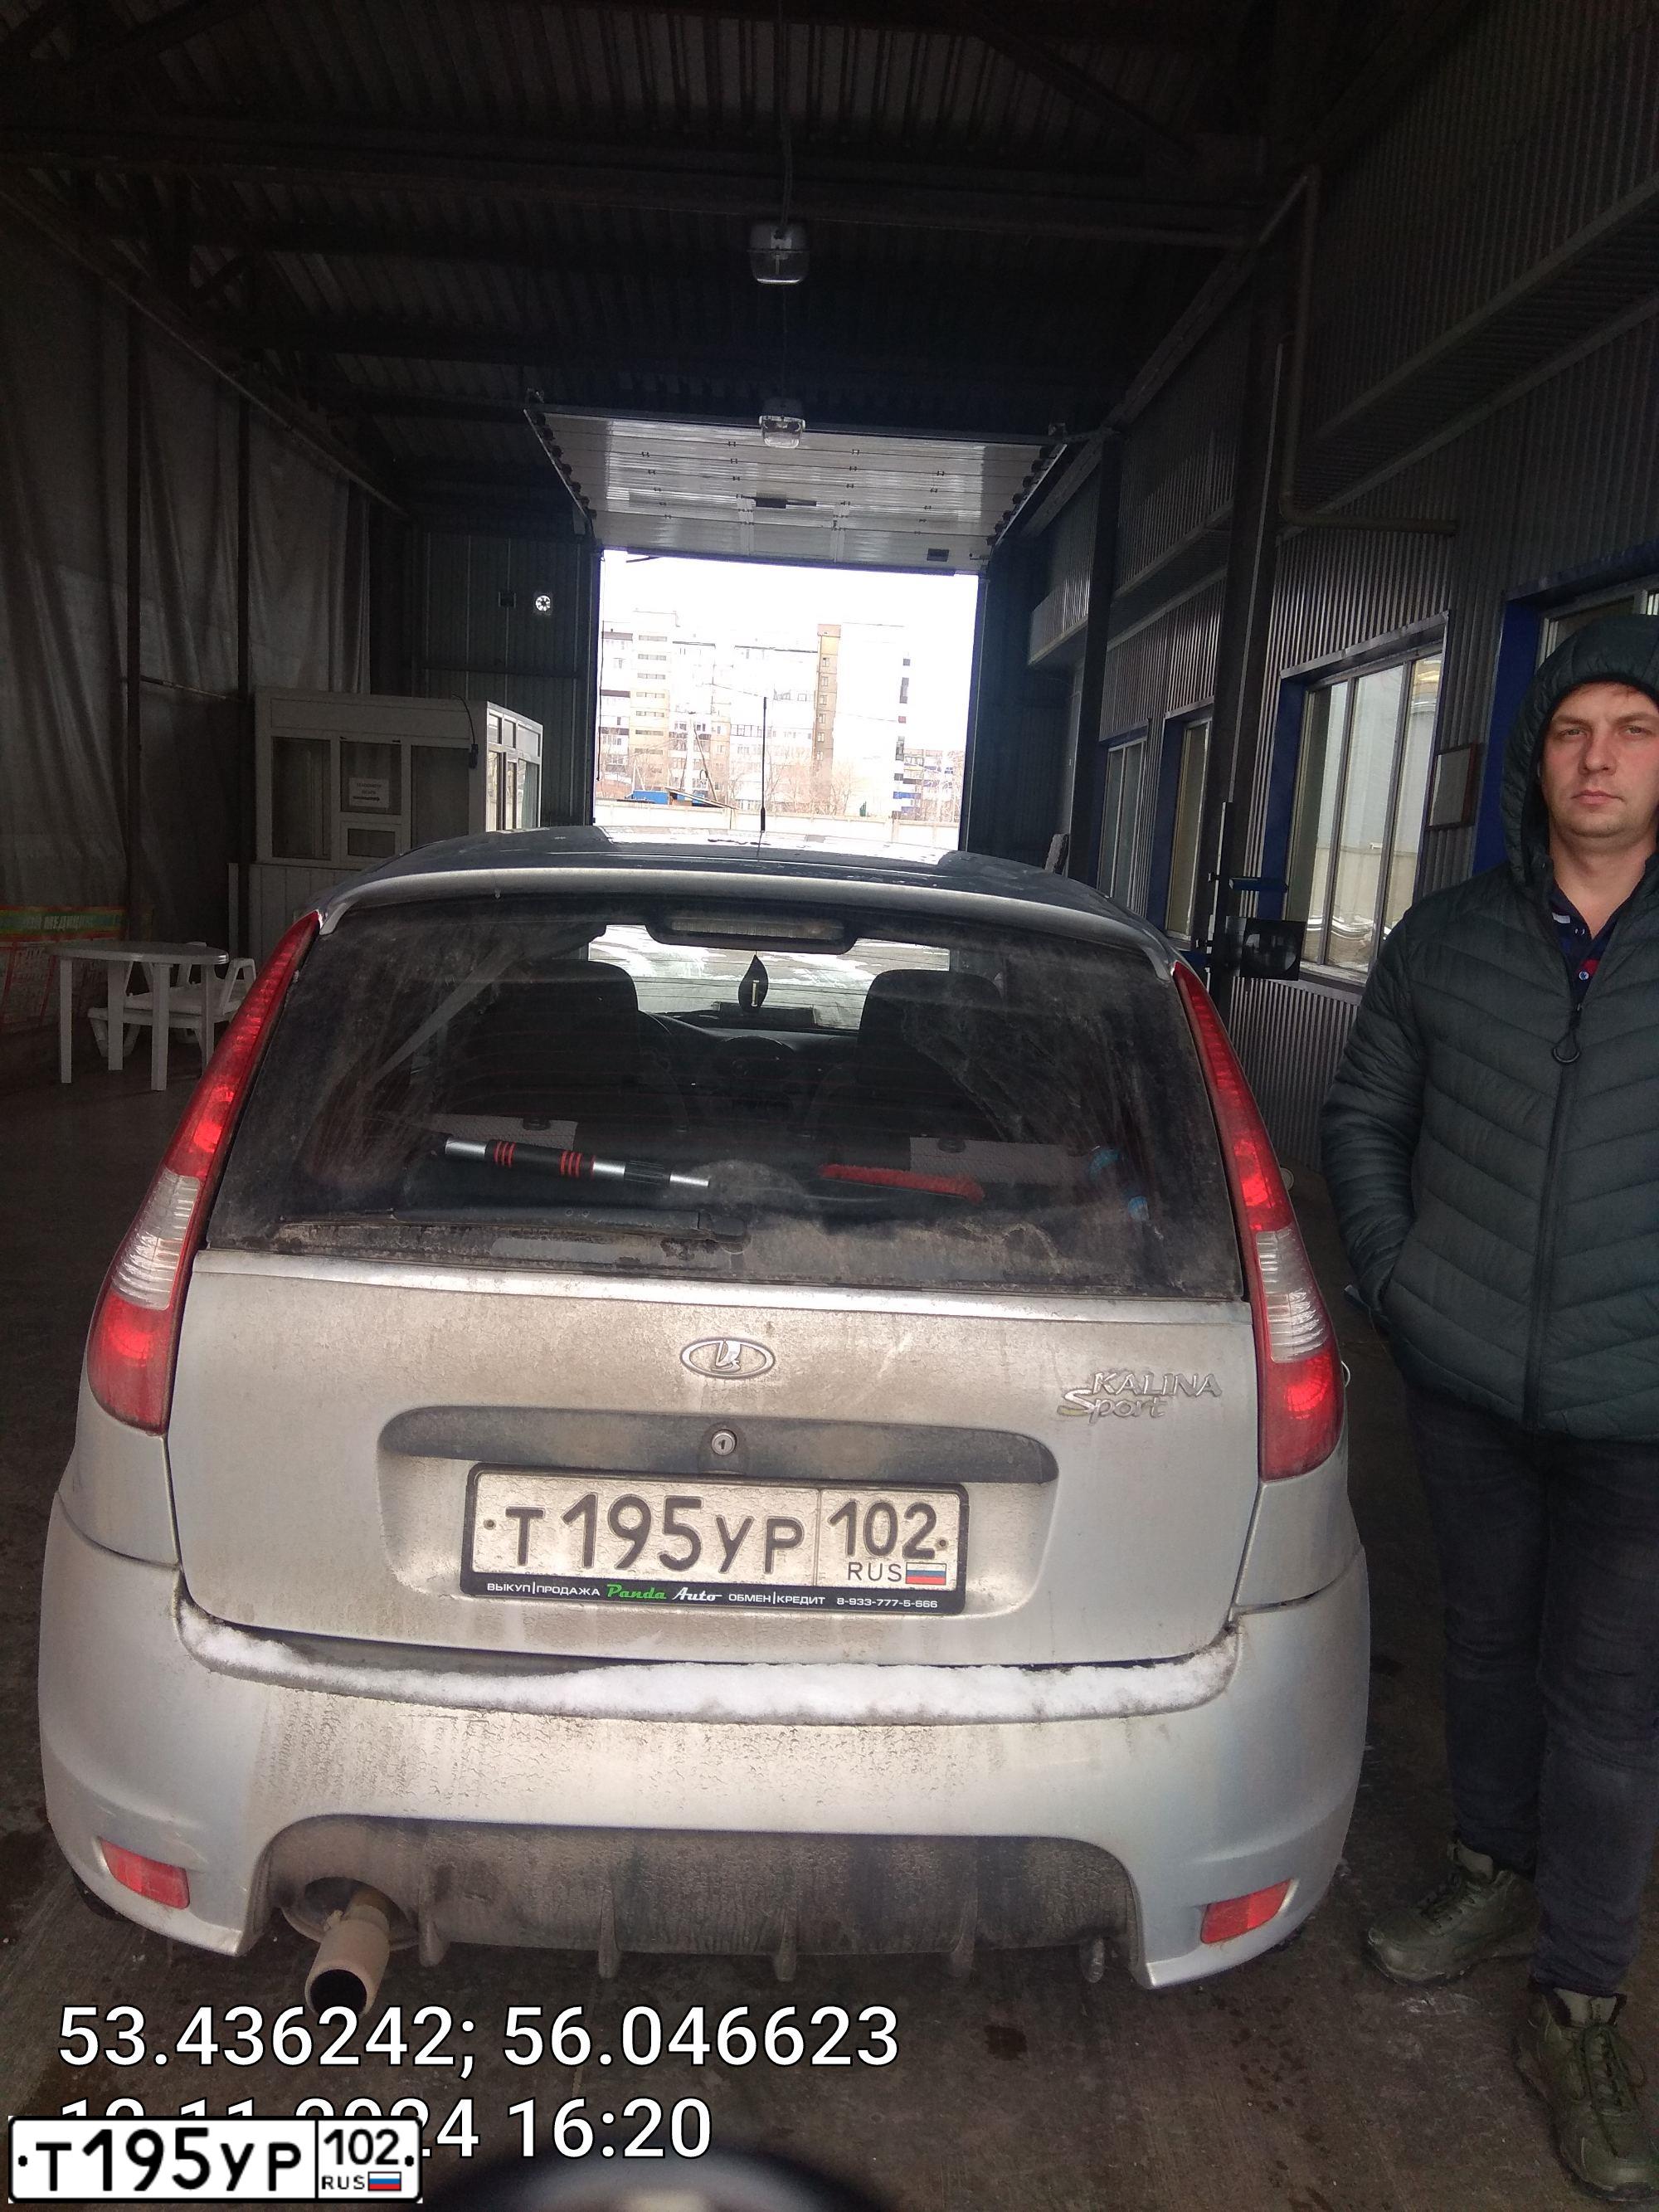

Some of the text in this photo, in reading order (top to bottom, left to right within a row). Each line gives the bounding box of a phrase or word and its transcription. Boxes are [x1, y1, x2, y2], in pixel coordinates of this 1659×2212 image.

[1092, 1372, 1223, 1397] KALINA
[1057, 1388, 1167, 1424] Sport
[504, 1493, 936, 1574] Т195УР 102
[847, 1562, 902, 1583] RUS
[606, 1584, 667, 1600] Panda
[672, 1586, 722, 1602] Auto
